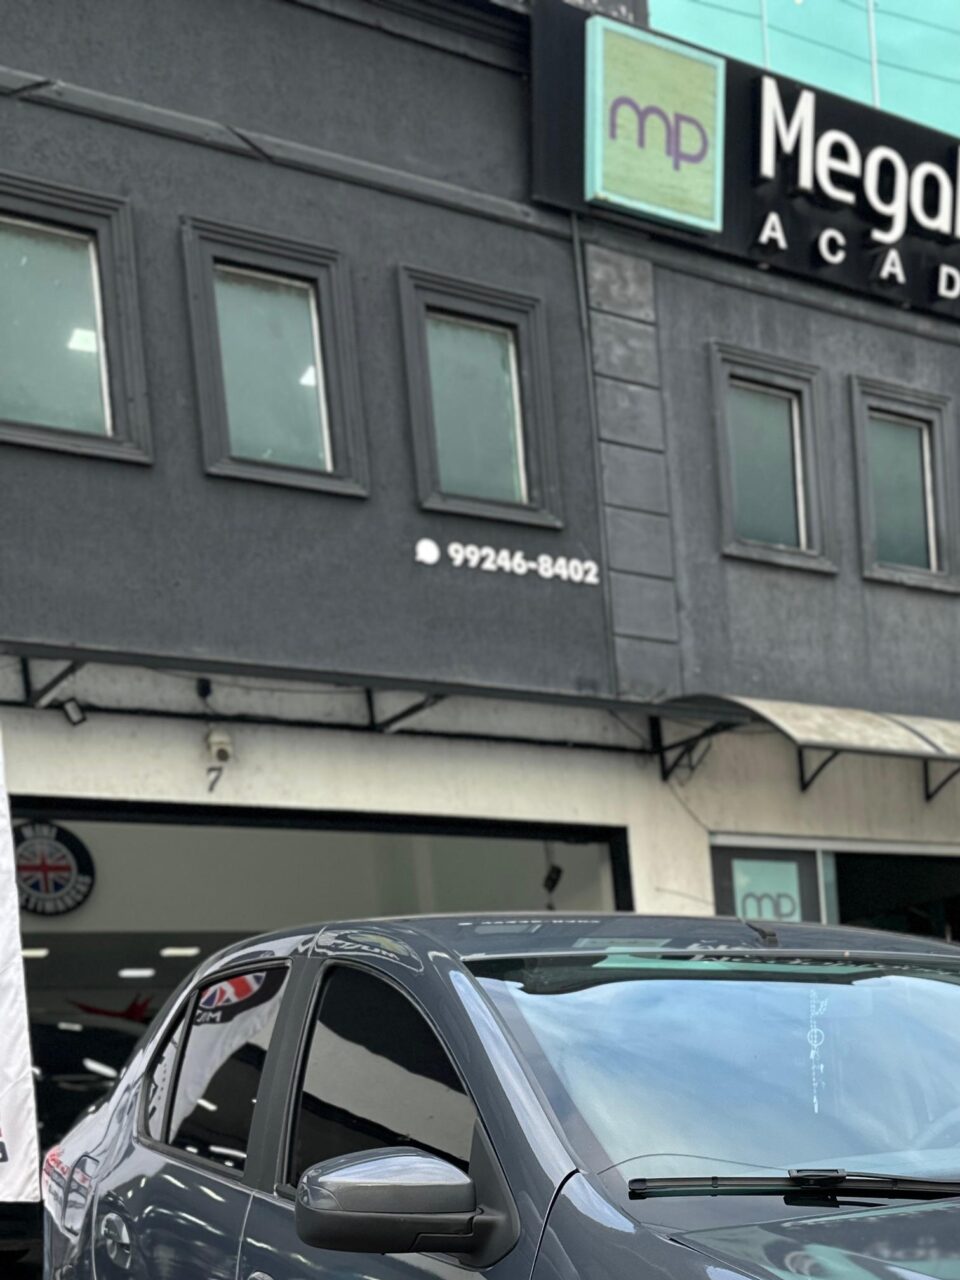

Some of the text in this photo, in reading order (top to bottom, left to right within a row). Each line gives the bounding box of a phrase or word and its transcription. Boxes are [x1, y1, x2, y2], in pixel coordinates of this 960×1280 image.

[609, 95, 709, 171] mp
[447, 541, 600, 585] 99246-8402
[206, 766, 223, 793] 7
